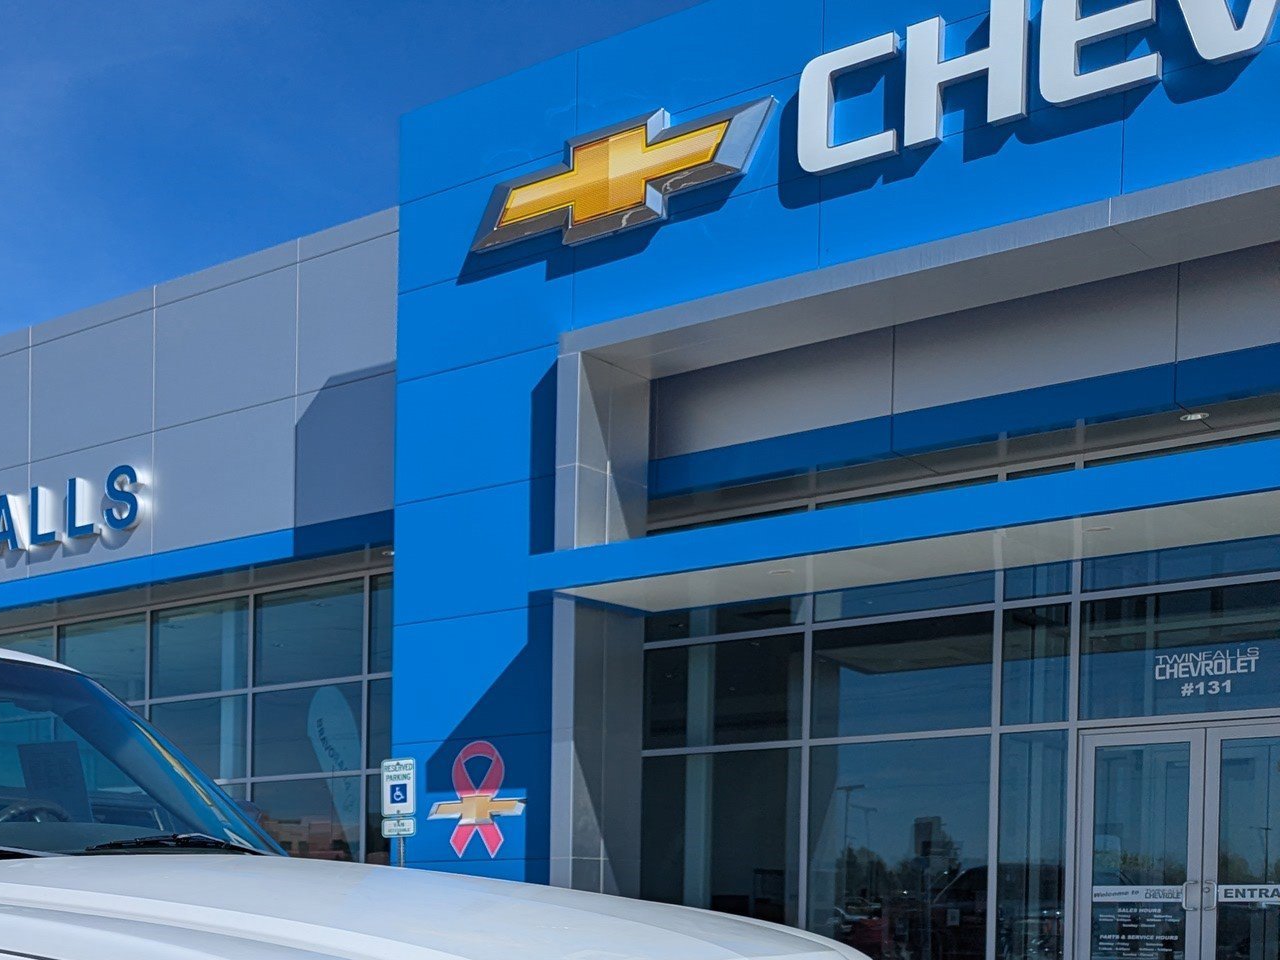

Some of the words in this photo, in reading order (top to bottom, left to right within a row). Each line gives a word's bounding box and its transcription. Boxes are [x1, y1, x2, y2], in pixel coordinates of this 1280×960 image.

[1155, 656, 1260, 680] CHEVROLET
[1180, 680, 1232, 696] #131
[384, 763, 414, 772] RESERVED
[385, 773, 411, 782] PARKING
